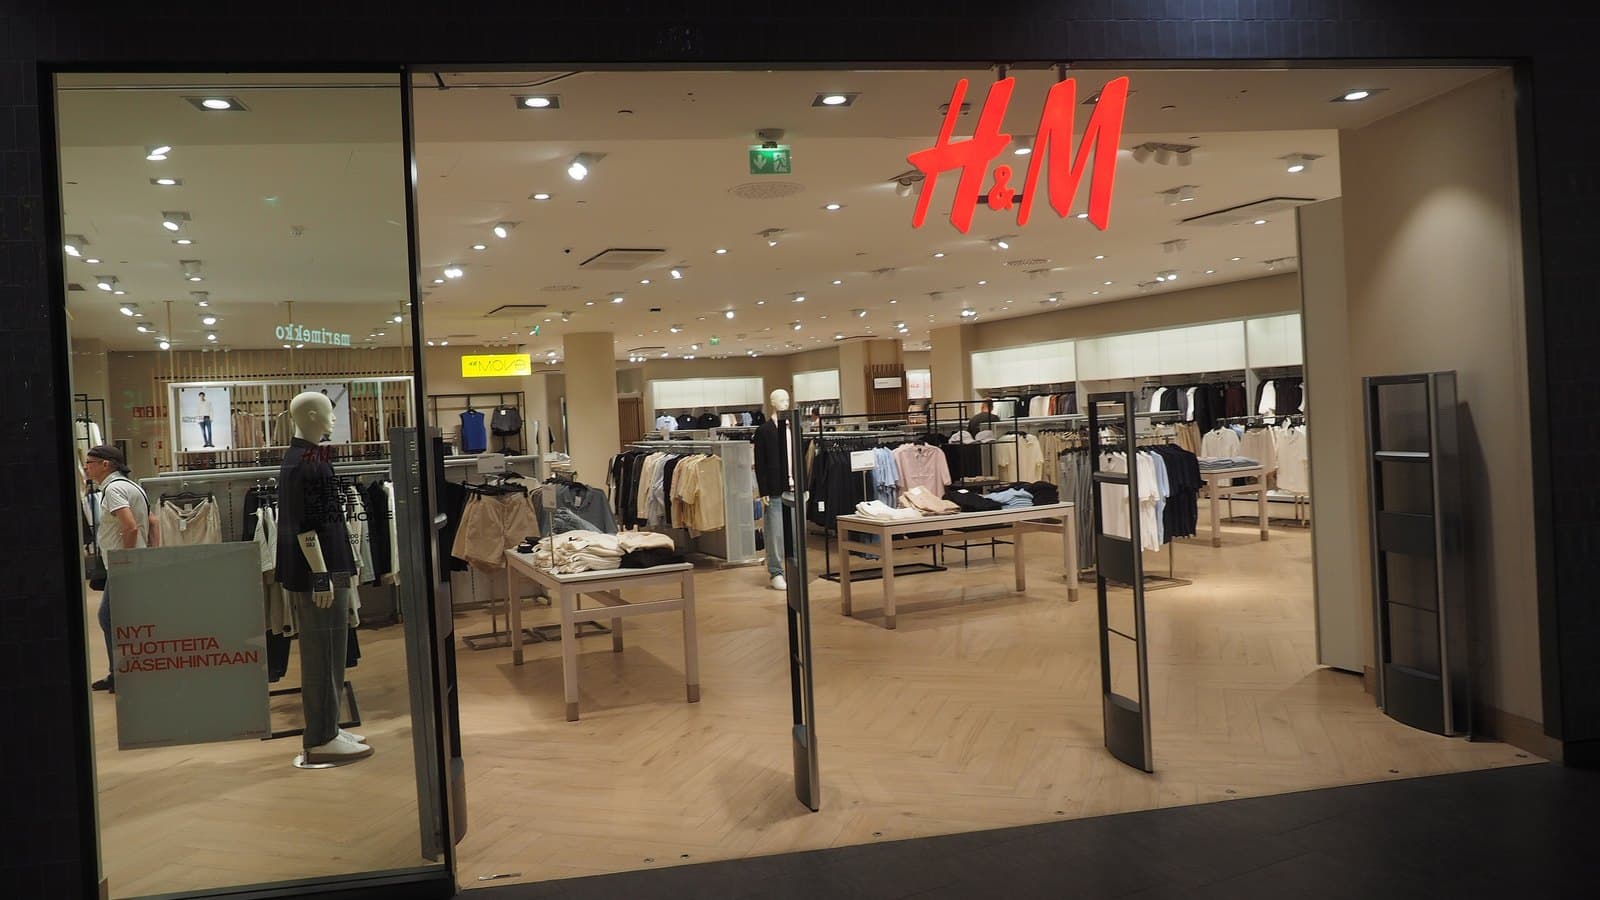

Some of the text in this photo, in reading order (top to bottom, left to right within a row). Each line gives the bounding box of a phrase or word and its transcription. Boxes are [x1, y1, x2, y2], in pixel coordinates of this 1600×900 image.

[906, 76, 1129, 234] H&M
[346, 510, 393, 522] HOE
[116, 624, 155, 640] NYT
[117, 637, 220, 656] TUOTTEITA
[118, 650, 258, 673] JÄSENHINTAAN
